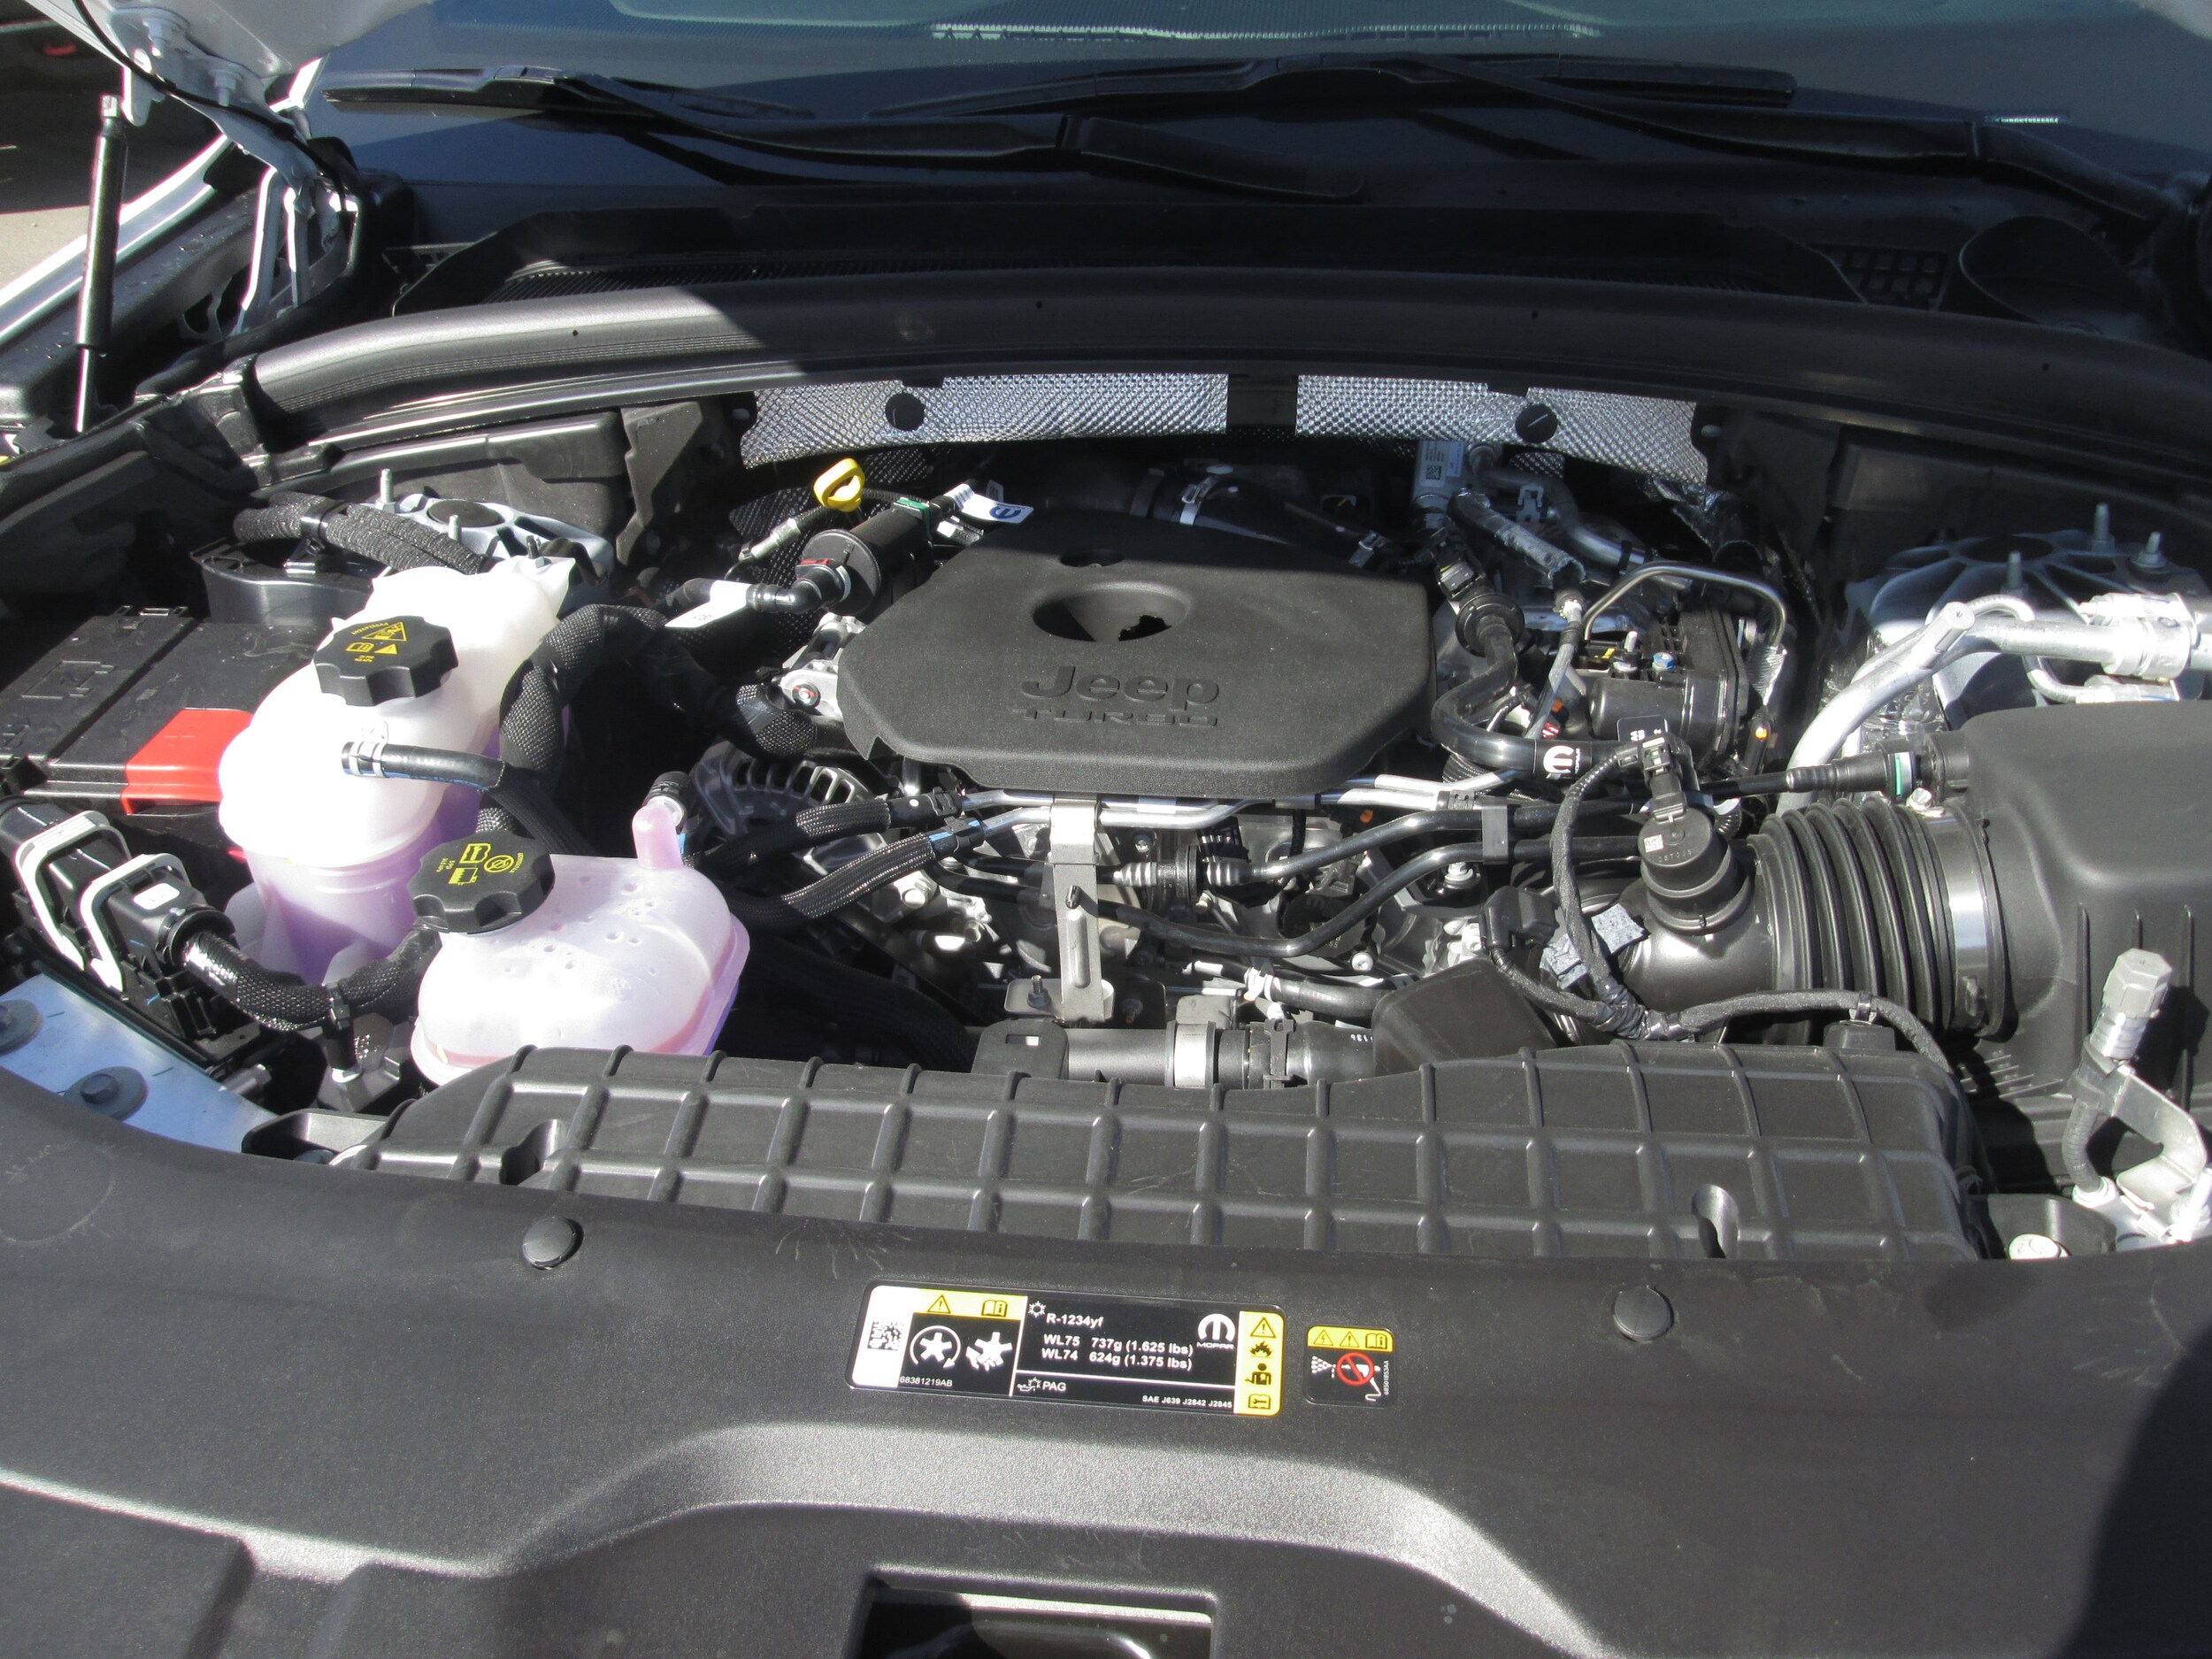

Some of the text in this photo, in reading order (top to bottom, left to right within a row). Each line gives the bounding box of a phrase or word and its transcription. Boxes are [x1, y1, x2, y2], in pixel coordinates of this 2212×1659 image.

[1020, 665, 1219, 711] Jeep
[1012, 708, 1218, 727] TURBO
[1046, 1313, 1104, 1329] R-1234yf
[1044, 1333, 1194, 1357] WL75 737g (1.625 lbs)
[1196, 1341, 1234, 1350] MOPAR
[1041, 1348, 1193, 1371] WL74 624g (1.375 lbs)
[899, 1375, 953, 1387] 68381219AB
[1042, 1380, 1067, 1392] PAG
[1141, 1394, 1233, 1409] SAE J639 J2842 J2845
